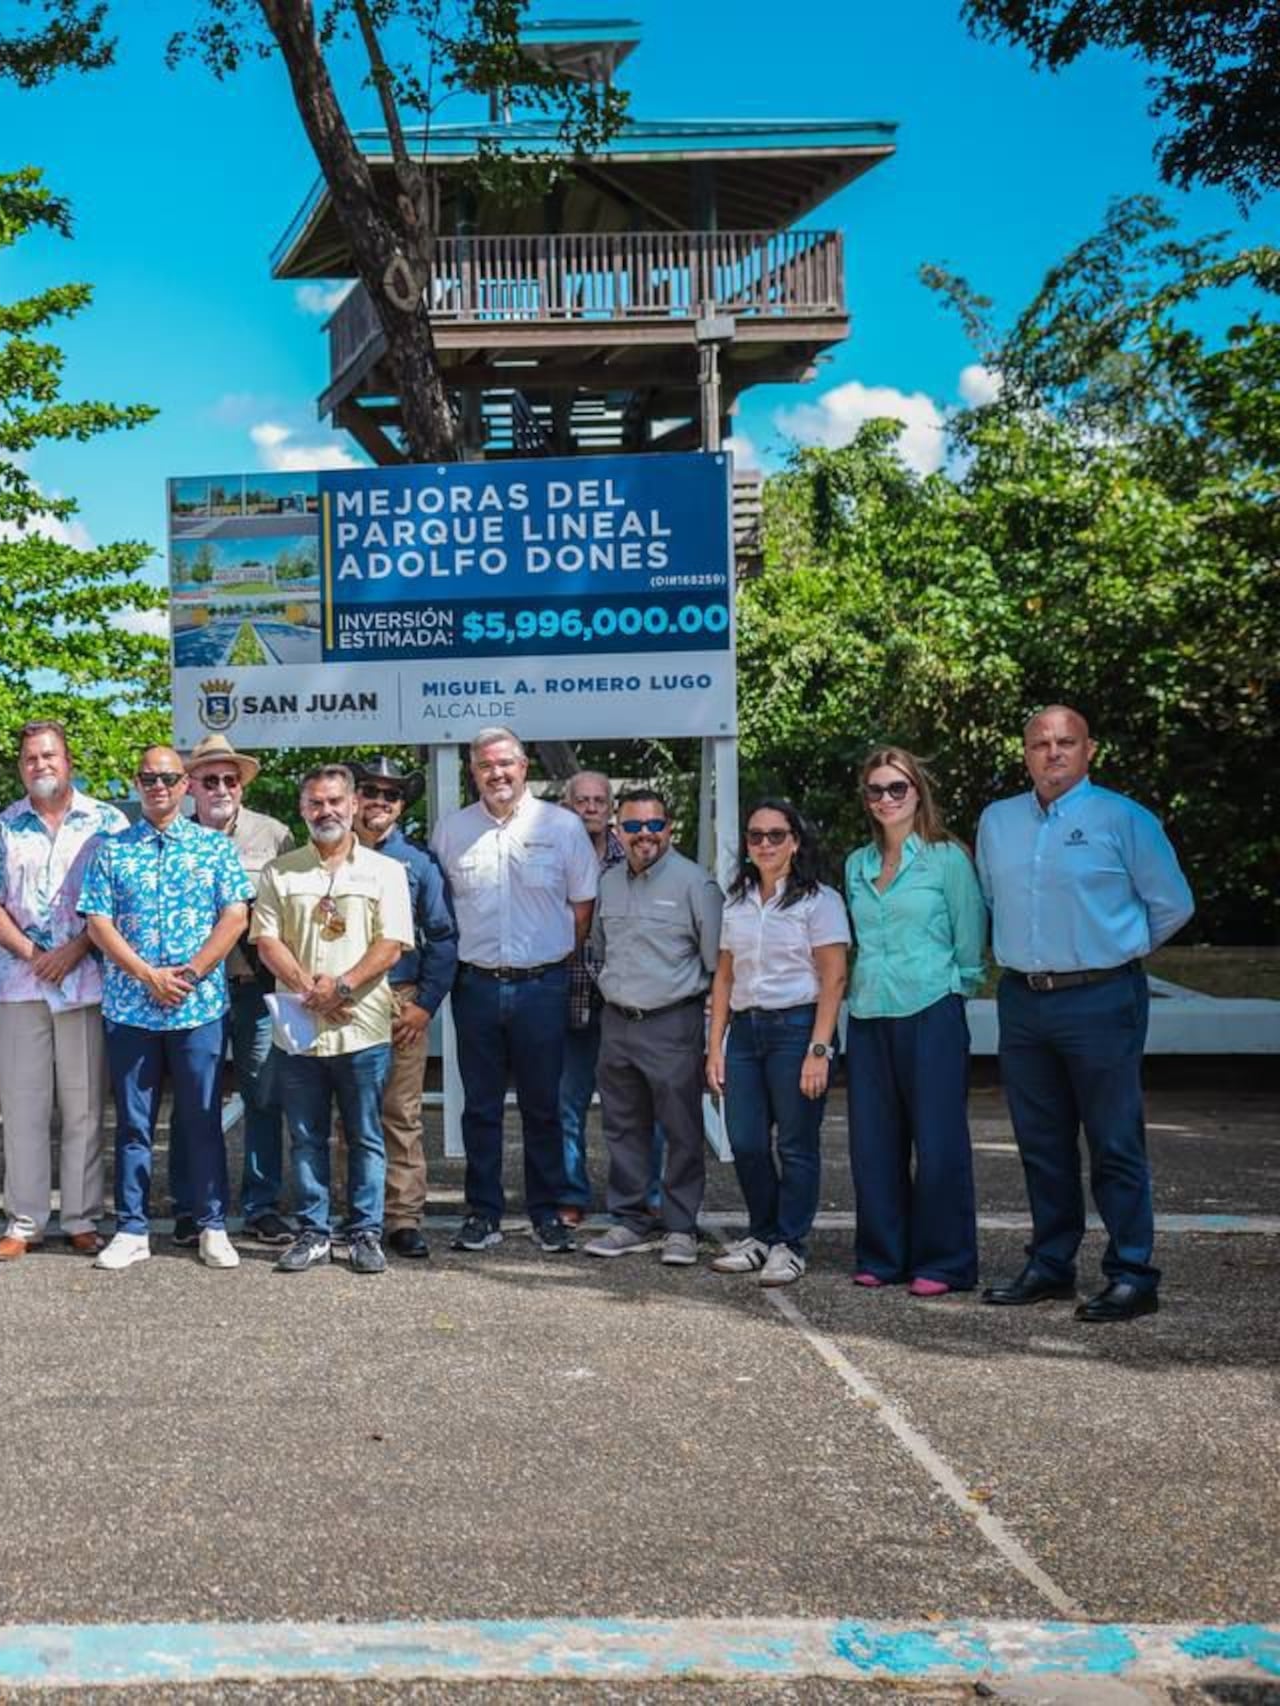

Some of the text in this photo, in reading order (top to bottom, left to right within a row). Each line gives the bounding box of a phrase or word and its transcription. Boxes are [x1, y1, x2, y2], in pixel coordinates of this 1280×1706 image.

[336, 480, 625, 517] MEJORAS DEL
[337, 510, 672, 548] PARQUE LINEAL
[337, 542, 669, 580] ADOLFO DONES
[338, 607, 453, 630] INVERSIÓN
[462, 604, 729, 642] $5,996,000.00
[338, 630, 454, 649] ESTIMADA:
[422, 674, 712, 697] MIGUEL A. ROMERO LUGO
[242, 692, 377, 714] SAN JUAN
[422, 702, 515, 719] ALCALDE
